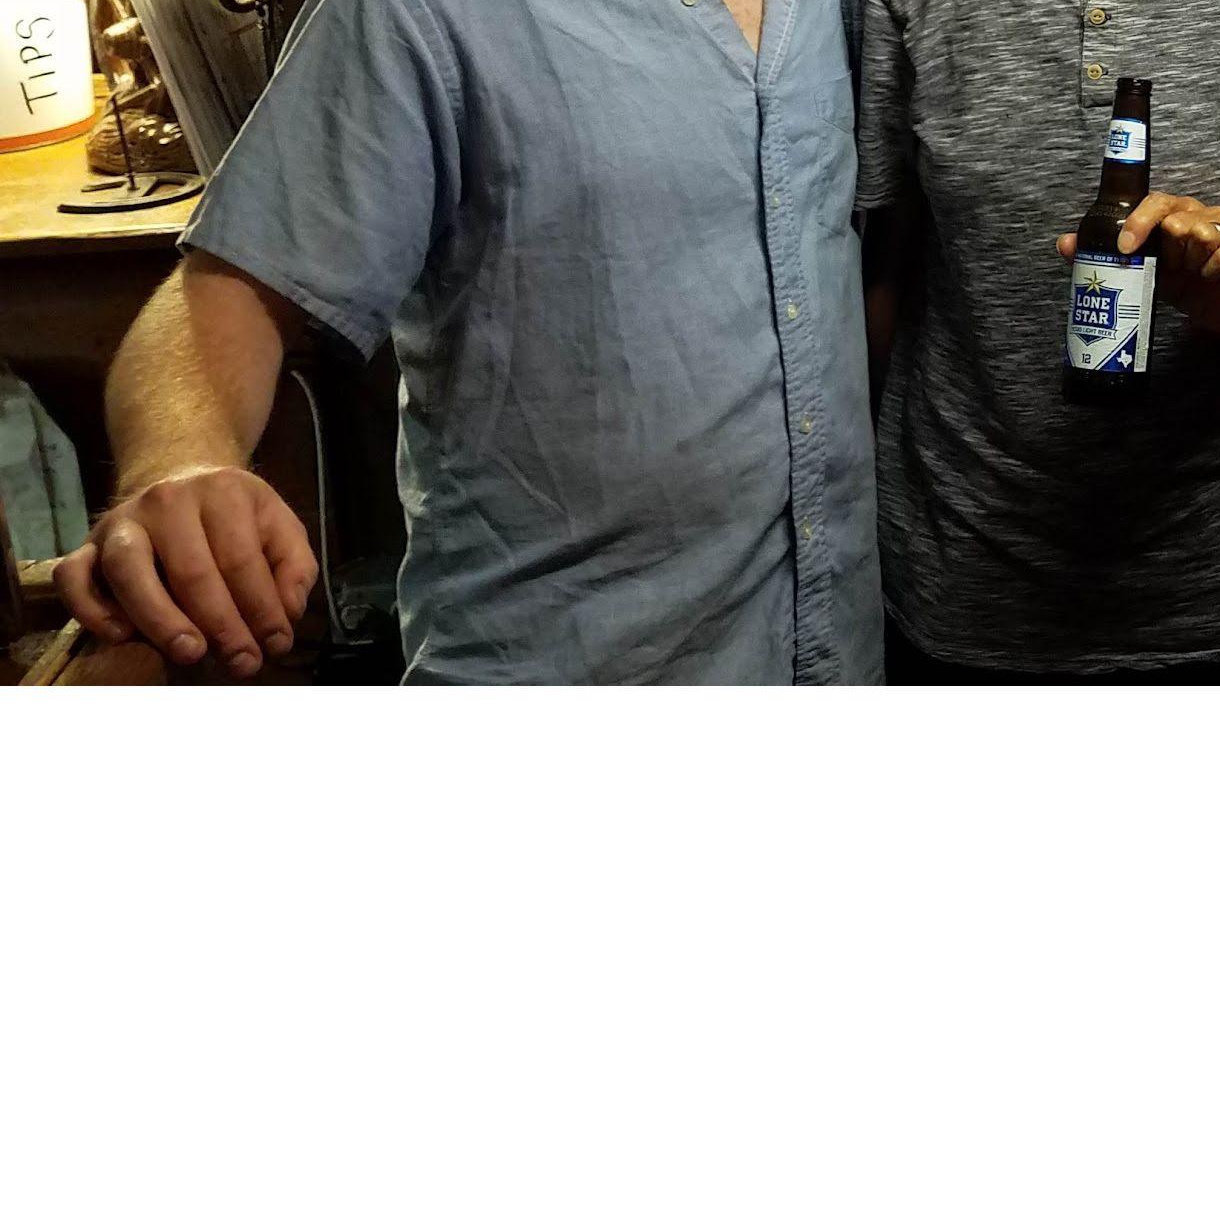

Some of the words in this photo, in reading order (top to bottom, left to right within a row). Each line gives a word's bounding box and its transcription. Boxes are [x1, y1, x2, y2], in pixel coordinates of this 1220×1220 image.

[15, 17, 58, 115] TIPS
[1076, 294, 1111, 310] LONE
[1075, 309, 1109, 325] STAR
[1081, 353, 1092, 364] 12
